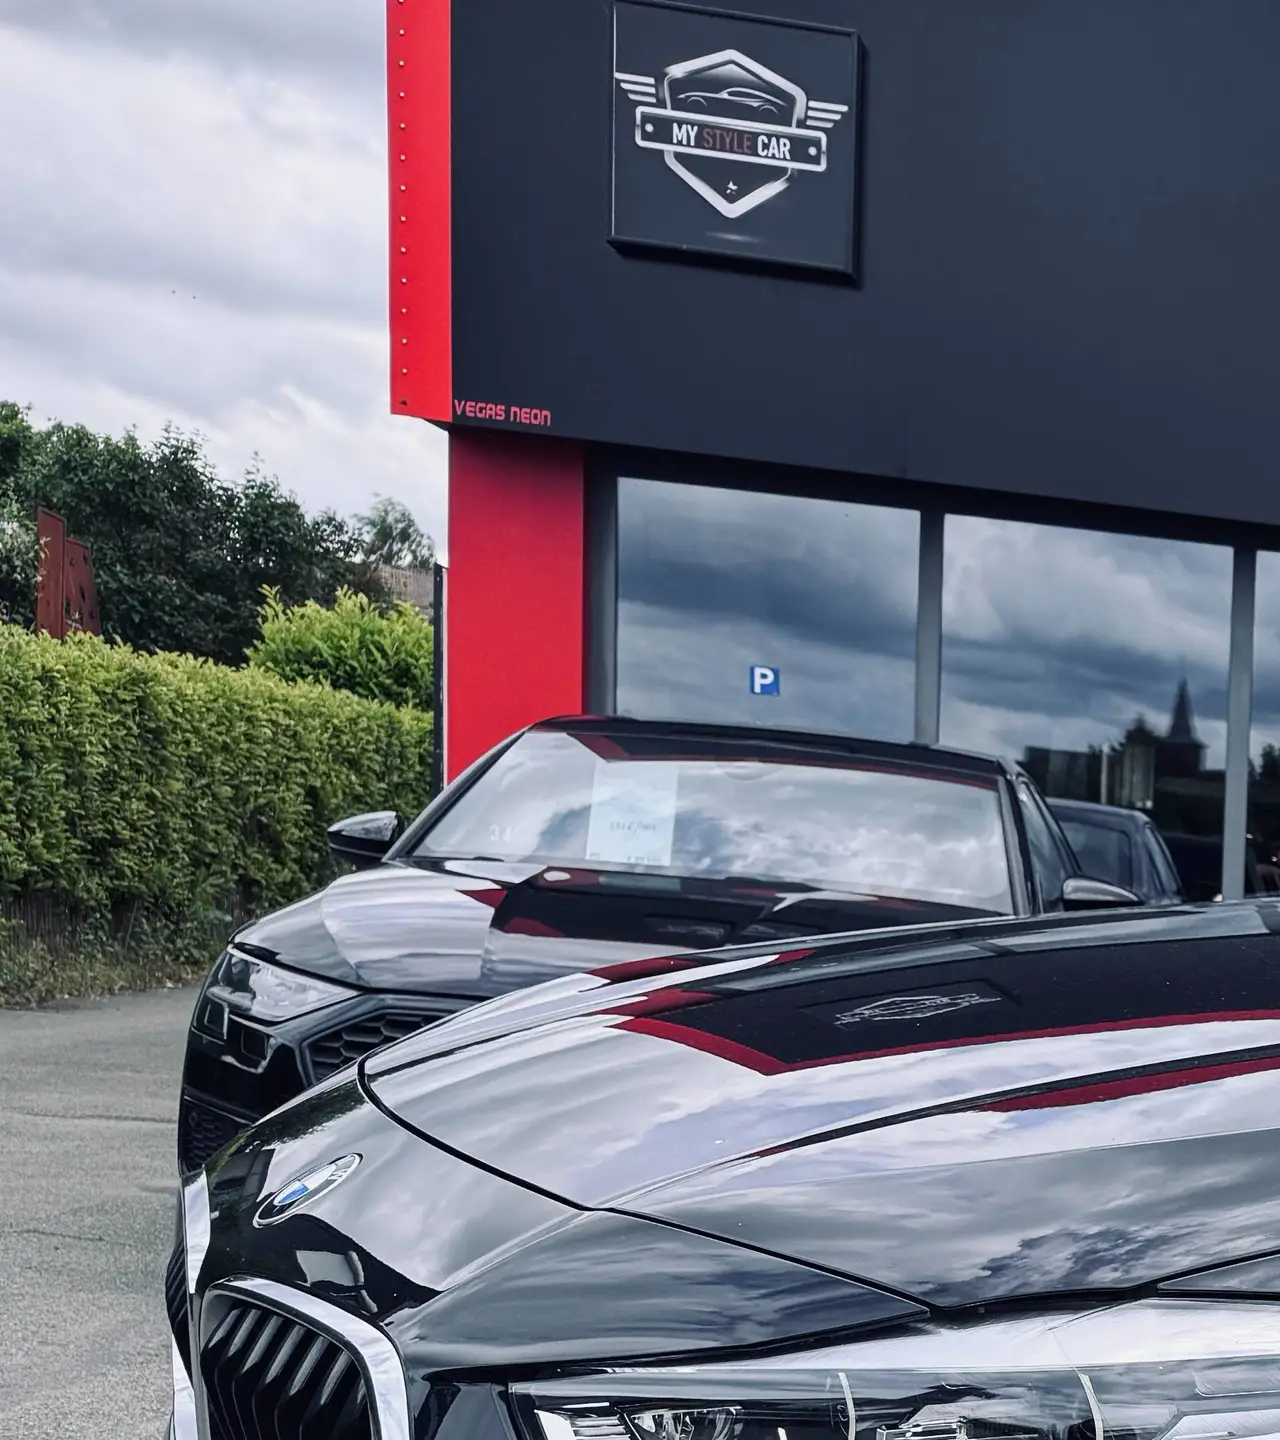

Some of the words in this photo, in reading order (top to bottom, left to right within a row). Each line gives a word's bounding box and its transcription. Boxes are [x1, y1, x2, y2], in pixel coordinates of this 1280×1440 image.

[672, 122, 699, 146] MY
[702, 127, 753, 154] STYLE
[756, 135, 791, 160] CAR
[454, 399, 505, 420] VEGAS
[510, 406, 551, 426] NEON
[753, 666, 775, 694] P
